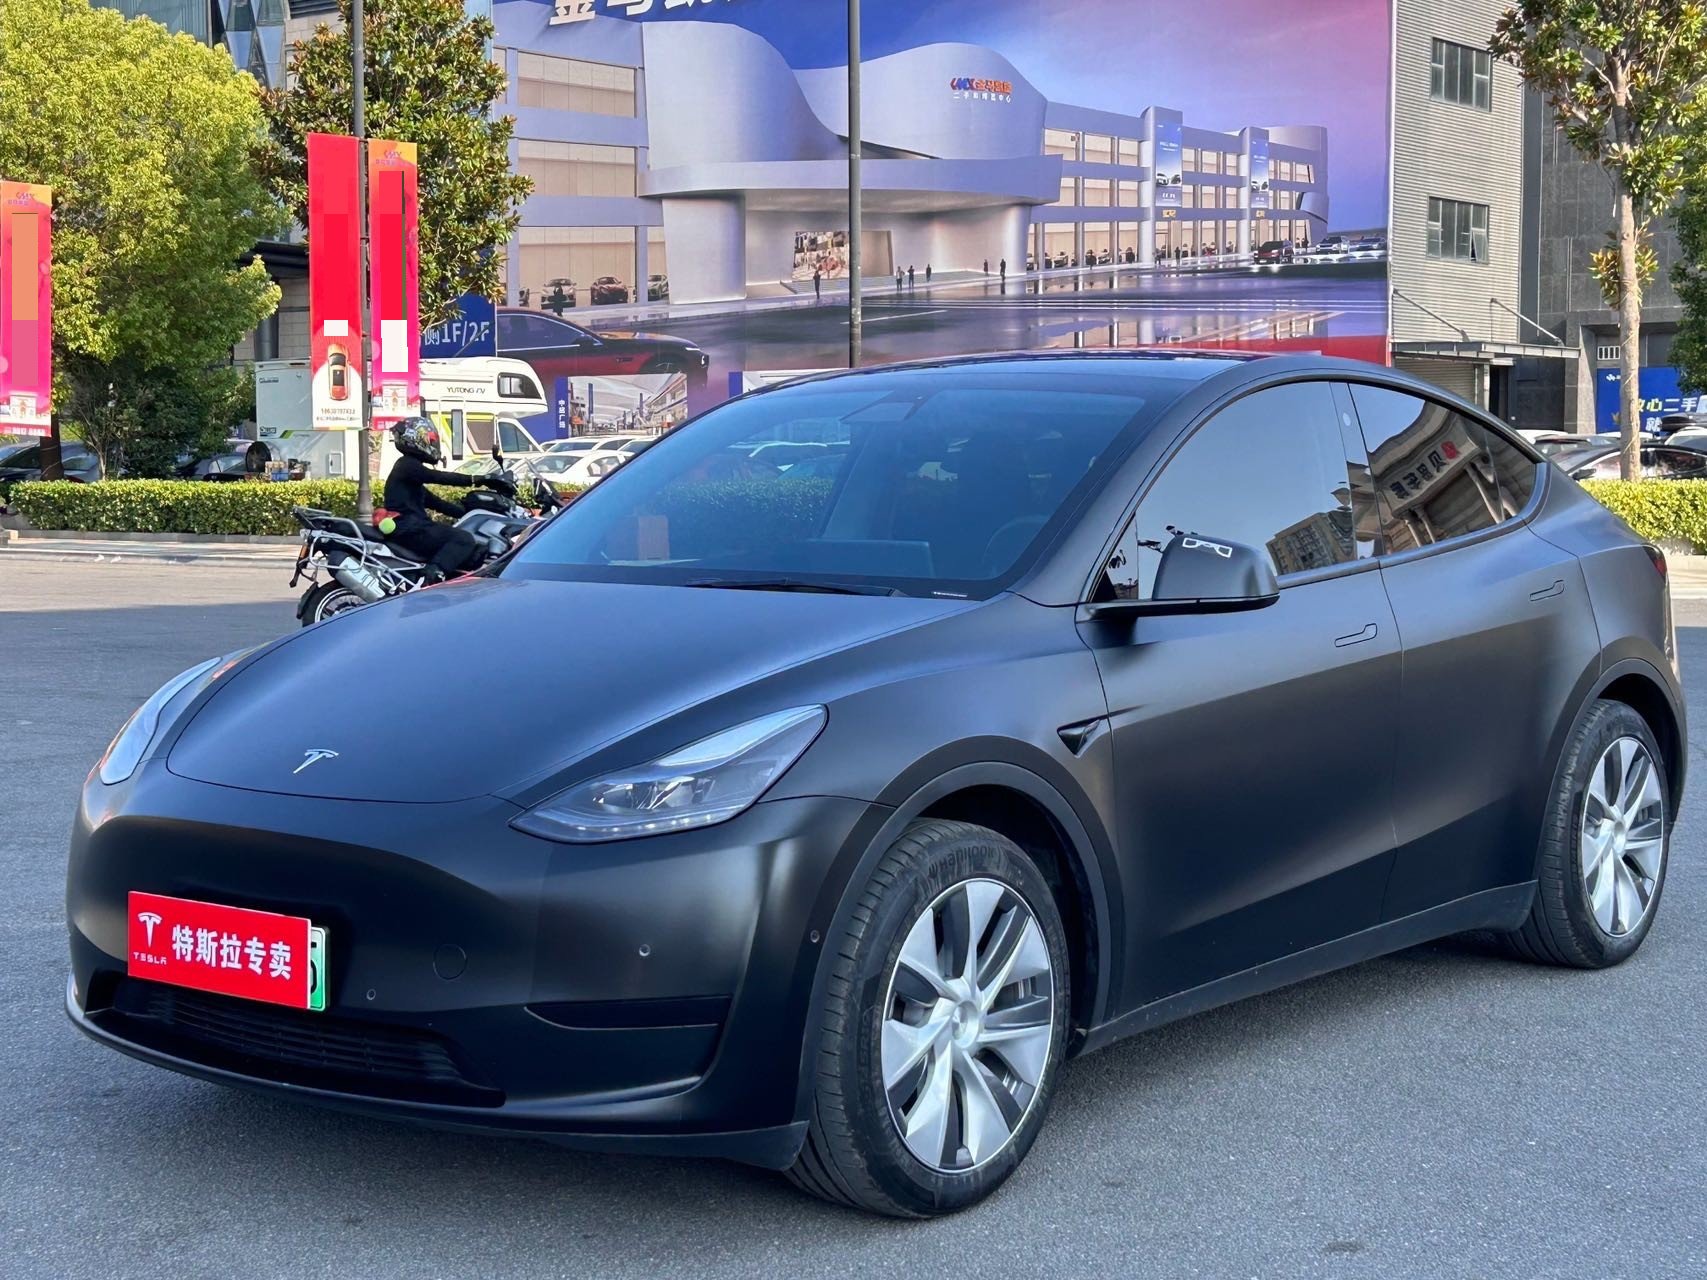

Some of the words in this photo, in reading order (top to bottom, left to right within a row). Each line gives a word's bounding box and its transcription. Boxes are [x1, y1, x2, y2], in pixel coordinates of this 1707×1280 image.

[133, 951, 167, 965] TESLA
[171, 924, 292, 980] 特斯拉专卖
